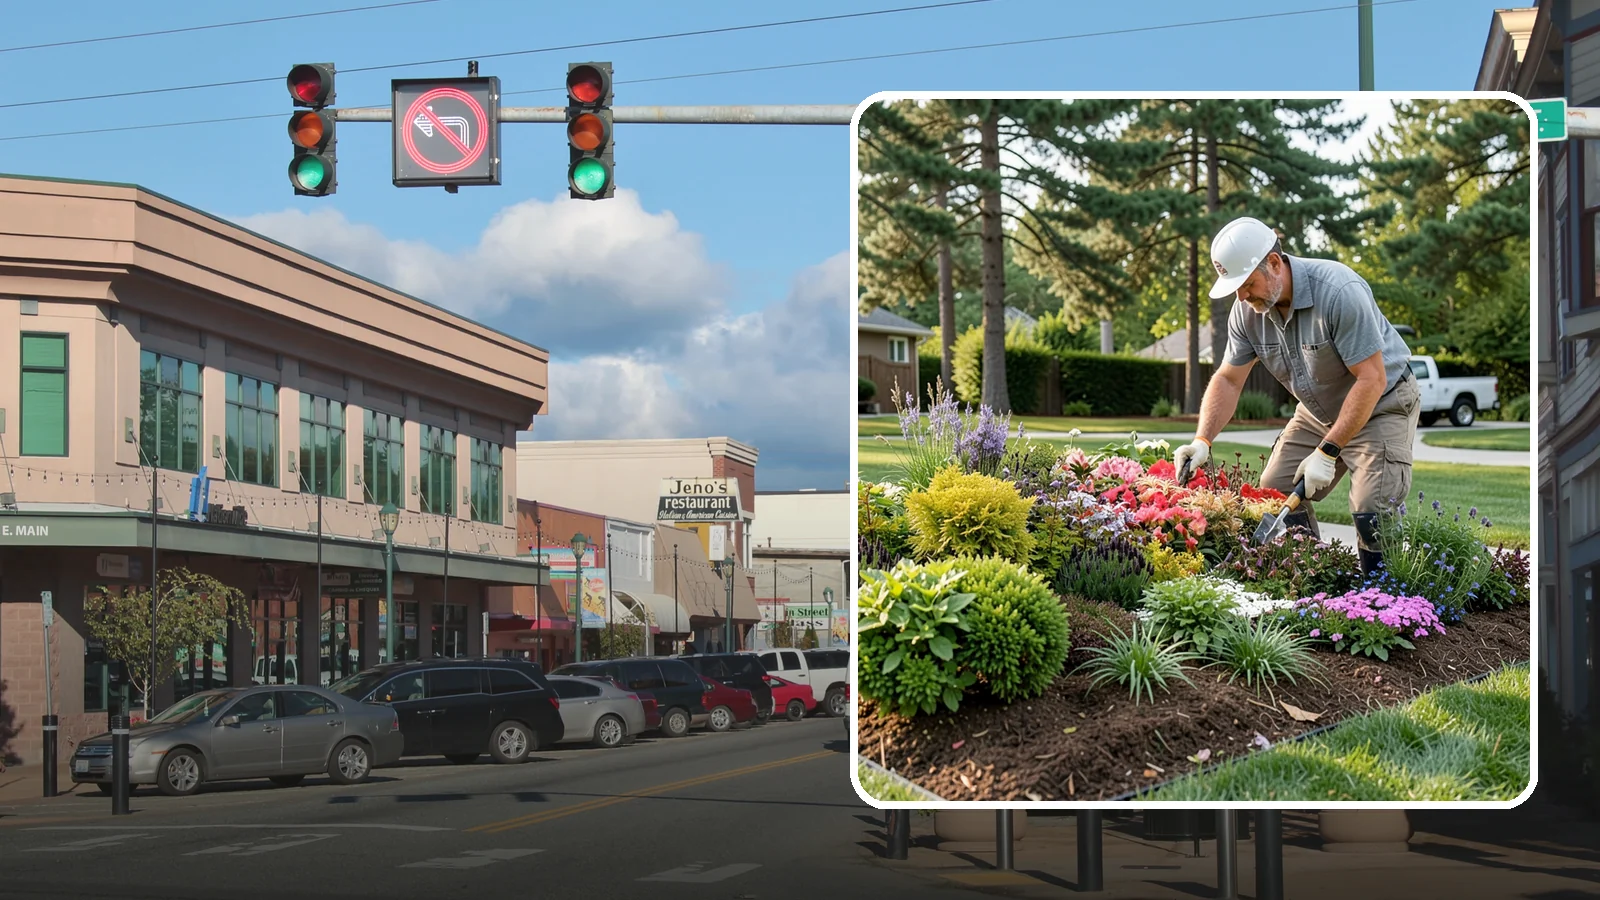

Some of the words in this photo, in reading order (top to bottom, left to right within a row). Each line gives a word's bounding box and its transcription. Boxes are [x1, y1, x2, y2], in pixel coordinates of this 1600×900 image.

[669, 480, 728, 495] Jeno's
[665, 496, 731, 509] restaurant
[686, 510, 714, 520] American
[715, 509, 737, 520] Cuisine
[2, 525, 13, 536] E.
[15, 525, 49, 536] MAIN
[786, 607, 794, 617] in
[797, 607, 828, 617] Street
[791, 619, 823, 627] lass
